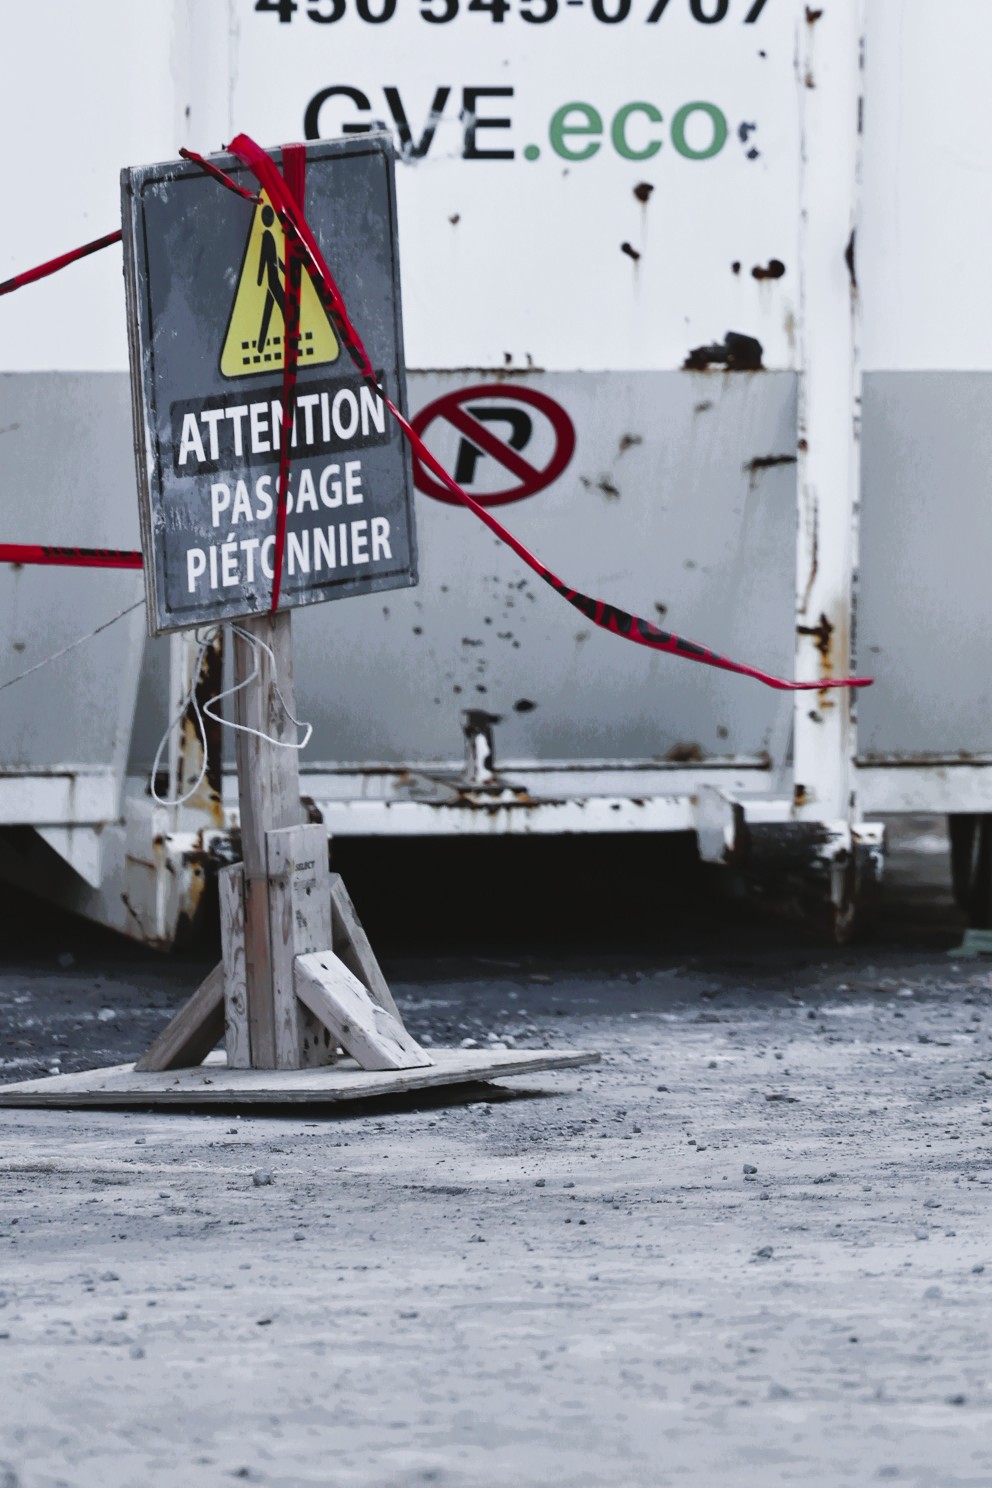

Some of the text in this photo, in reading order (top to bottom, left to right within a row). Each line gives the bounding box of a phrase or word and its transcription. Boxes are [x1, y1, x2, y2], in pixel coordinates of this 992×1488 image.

[303, 85, 728, 161] GVE.eco
[177, 383, 387, 466] ATTENTION
[186, 516, 393, 594] PIÉTONNIER
